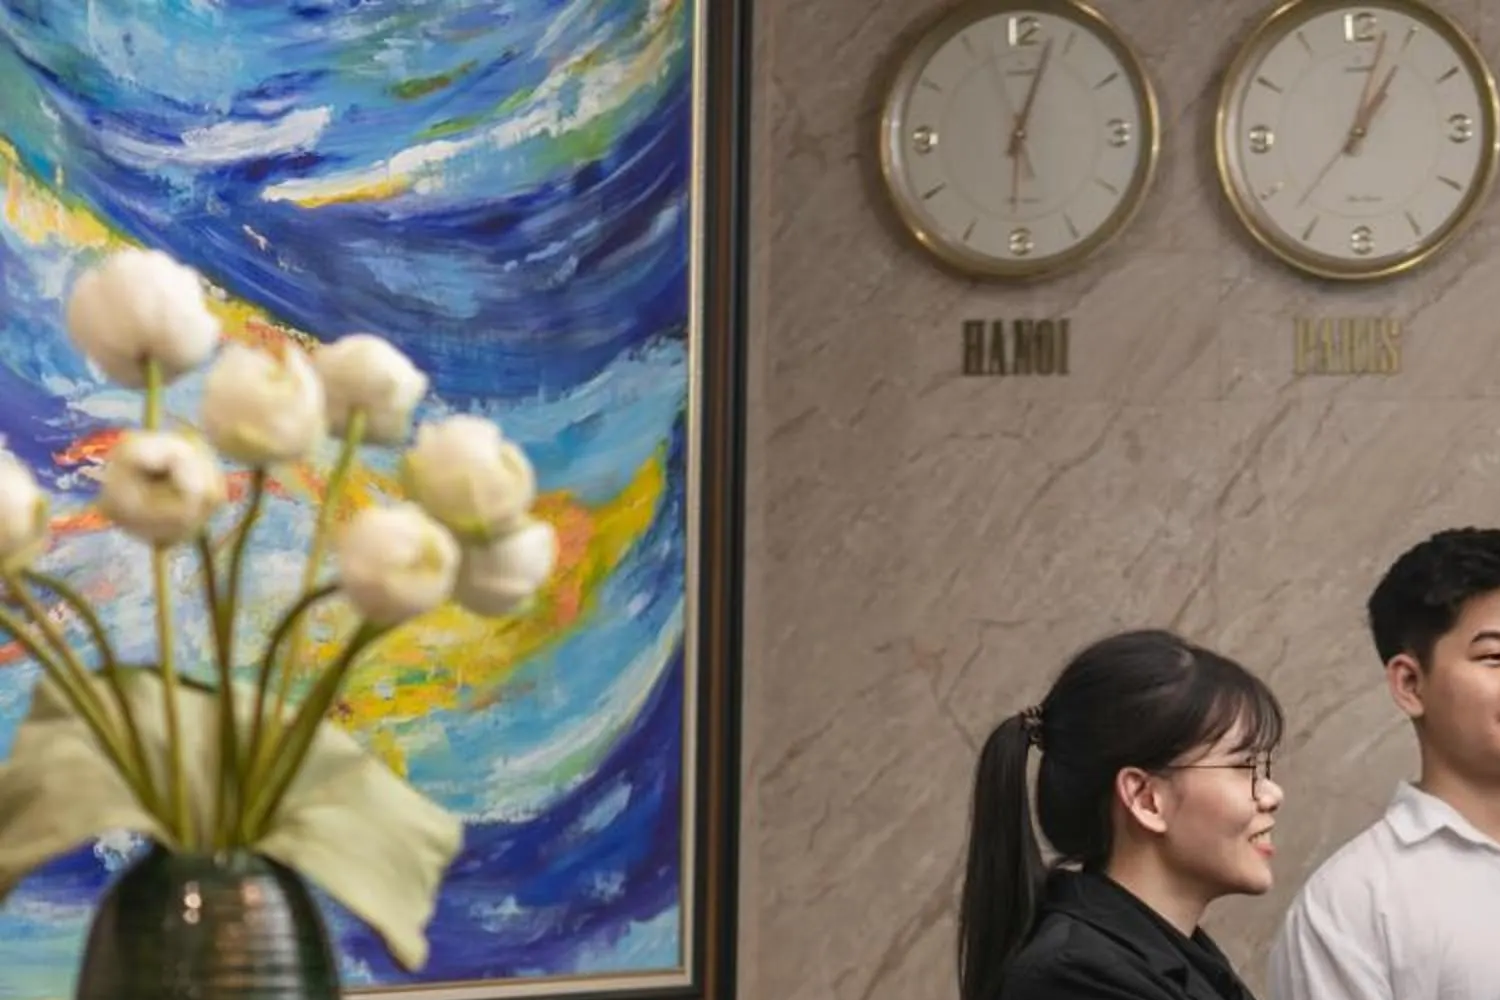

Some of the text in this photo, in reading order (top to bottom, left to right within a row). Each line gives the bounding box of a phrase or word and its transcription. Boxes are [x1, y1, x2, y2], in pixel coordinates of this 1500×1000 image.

[1007, 15, 1042, 47] 12
[1344, 12, 1378, 43] 12
[912, 124, 939, 155] 9
[1106, 118, 1131, 148] 3
[1249, 123, 1275, 154] 9
[1447, 113, 1472, 144] 3
[962, 318, 1070, 376] HANOI
